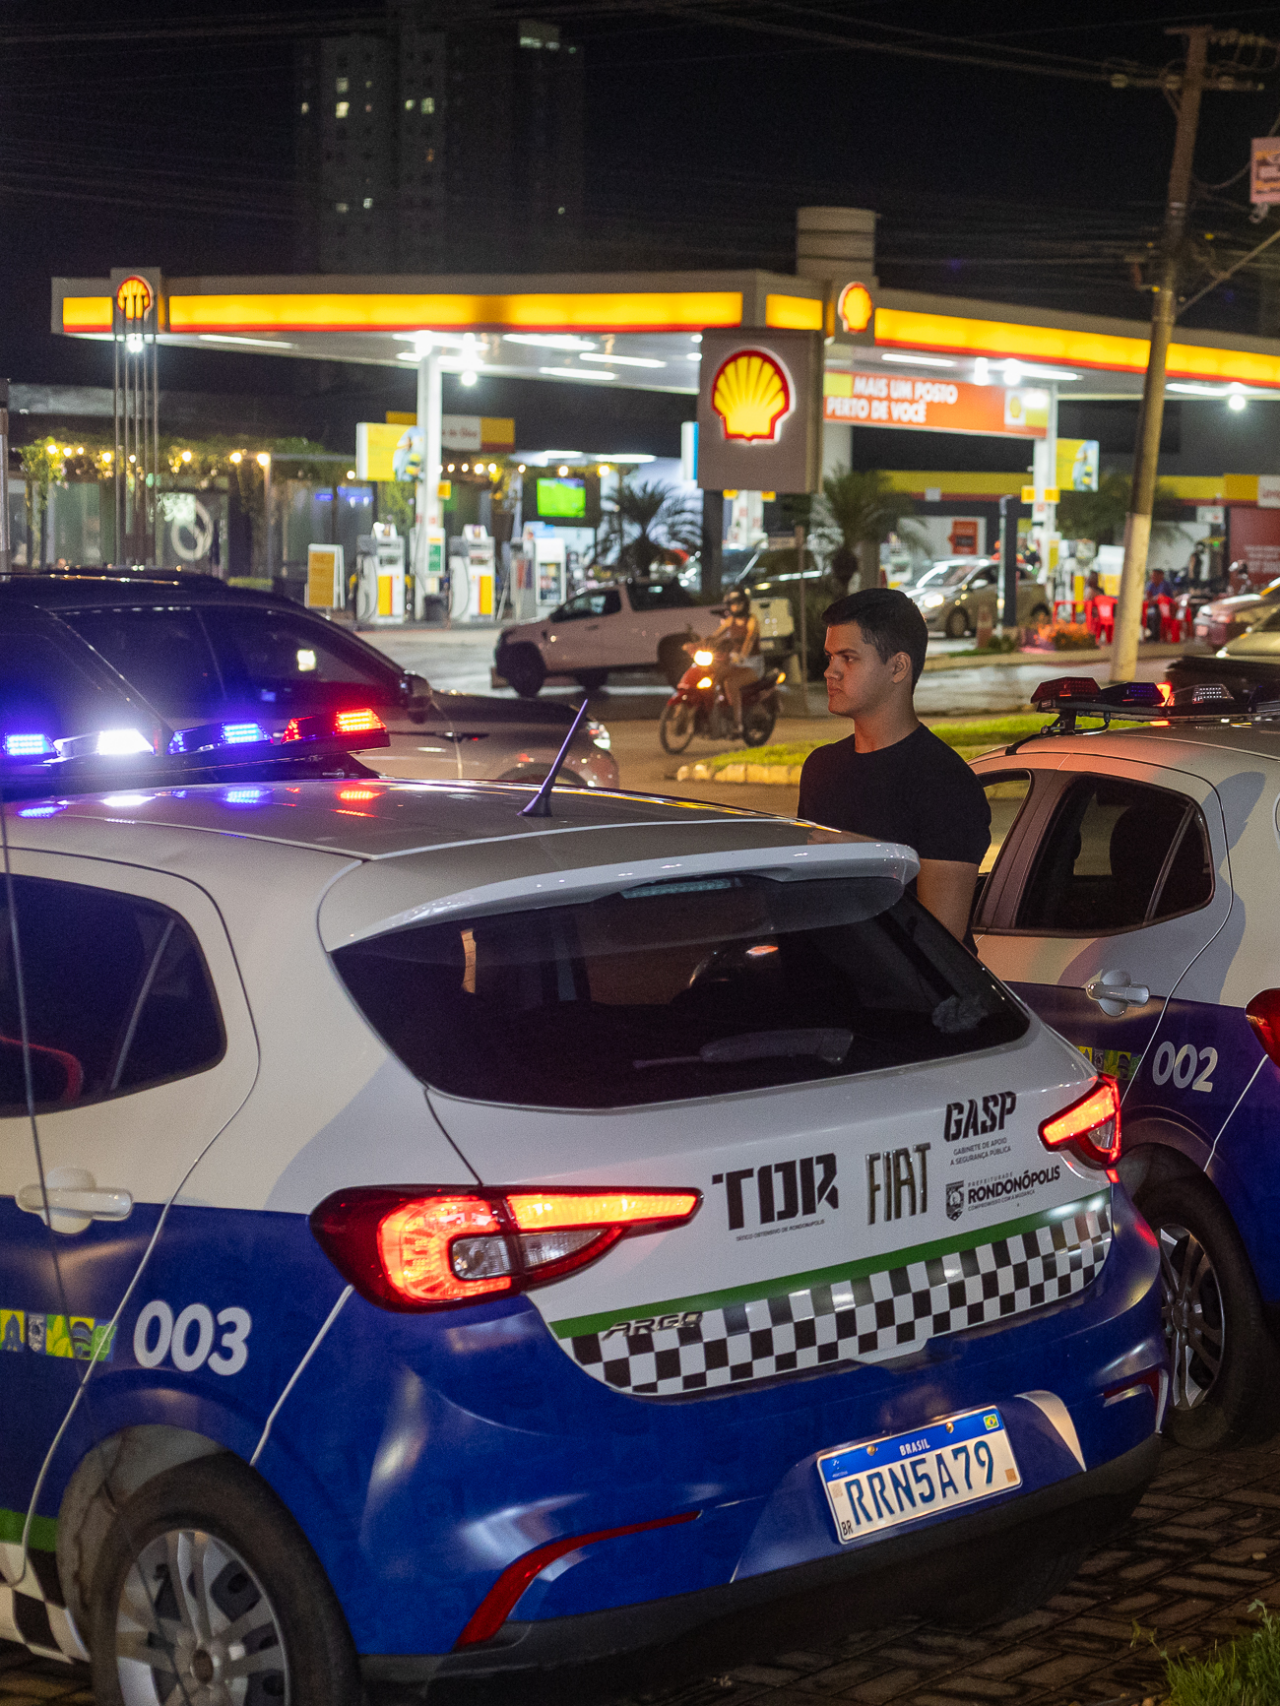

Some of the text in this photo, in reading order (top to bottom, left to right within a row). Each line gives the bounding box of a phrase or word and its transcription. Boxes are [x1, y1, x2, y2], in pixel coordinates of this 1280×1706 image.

[826, 397, 927, 423] PERTO DE VOCÊ
[853, 376, 958, 405] MAIS UM POSTO
[1152, 1041, 1218, 1093] 002
[943, 1091, 1017, 1142] GASP
[953, 1143, 981, 1156] GABINETE
[981, 1141, 989, 1149] DE
[711, 1152, 839, 1231] TOR
[865, 1142, 931, 1225] FIAT
[968, 1165, 1061, 1204] RONDONÓPOLIS
[133, 1300, 252, 1376] 003
[601, 1311, 703, 1341] ARGO
[899, 1438, 931, 1456] BRASIL
[844, 1440, 994, 1526] RRN5A79
[841, 1520, 853, 1536] BR
